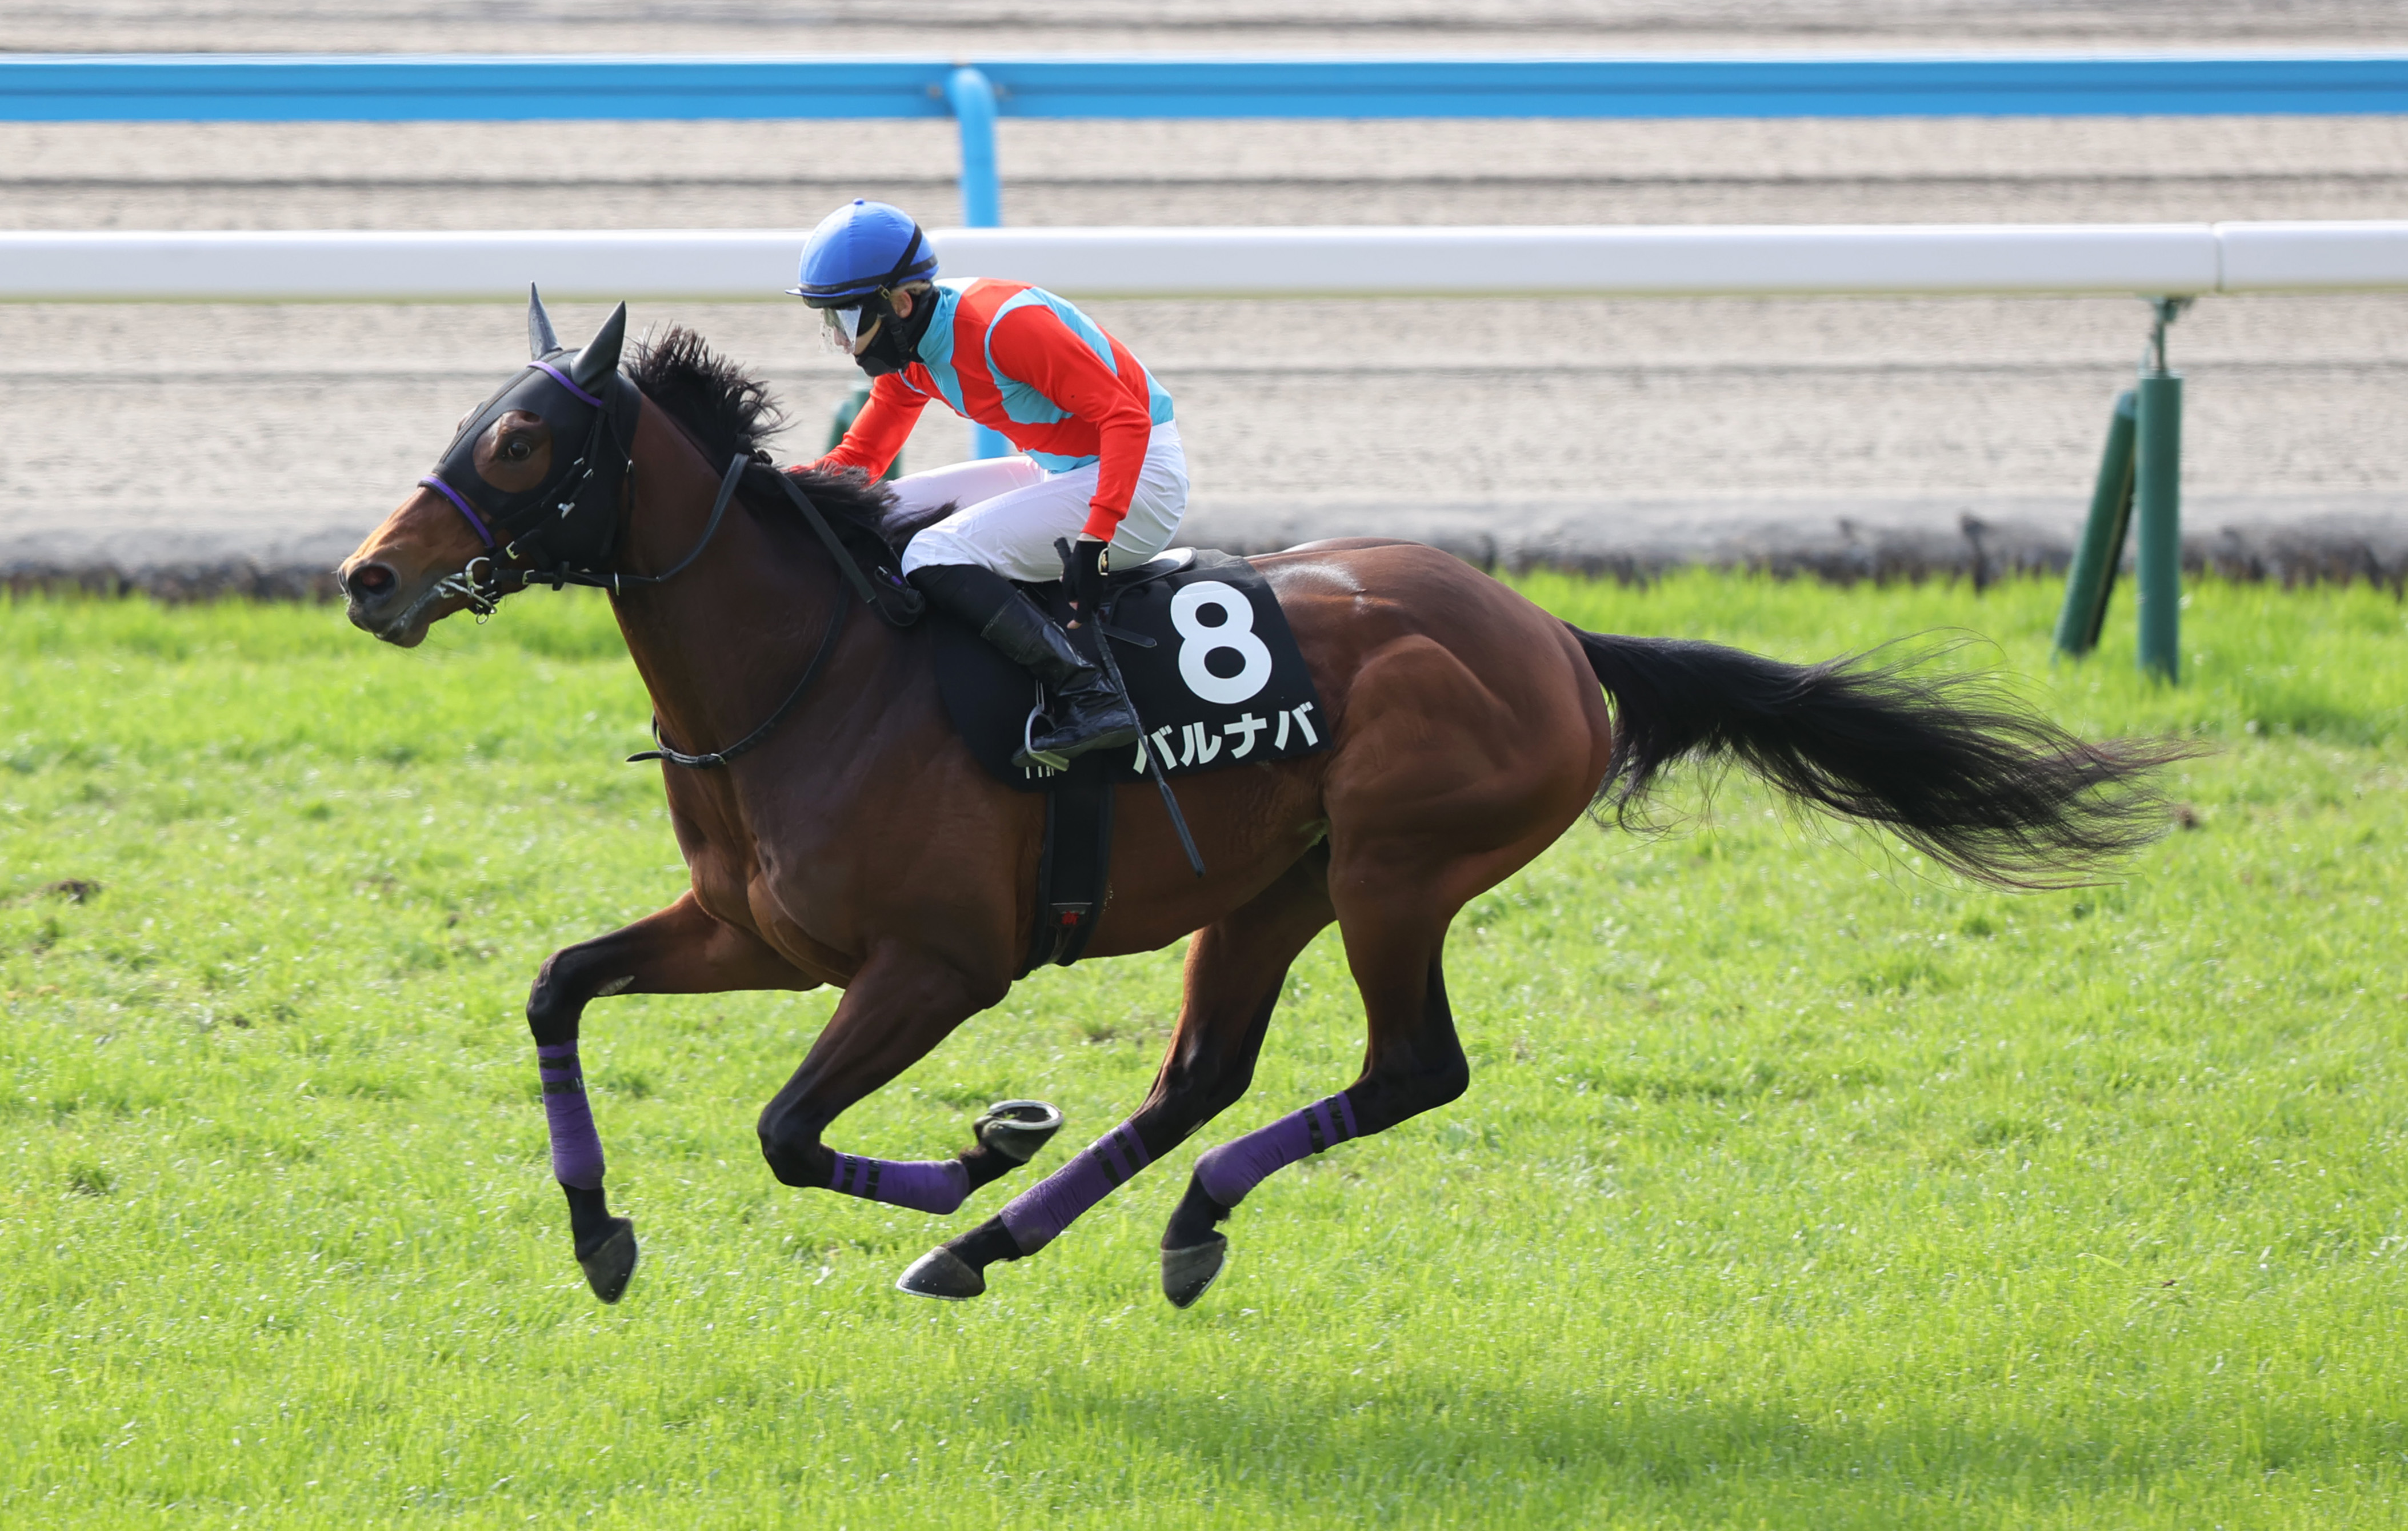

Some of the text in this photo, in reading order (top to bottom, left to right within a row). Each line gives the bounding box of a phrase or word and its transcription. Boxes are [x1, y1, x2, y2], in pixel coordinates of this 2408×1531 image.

[1170, 581, 1272, 704] 8
[1133, 702, 1318, 774] バルナバ
